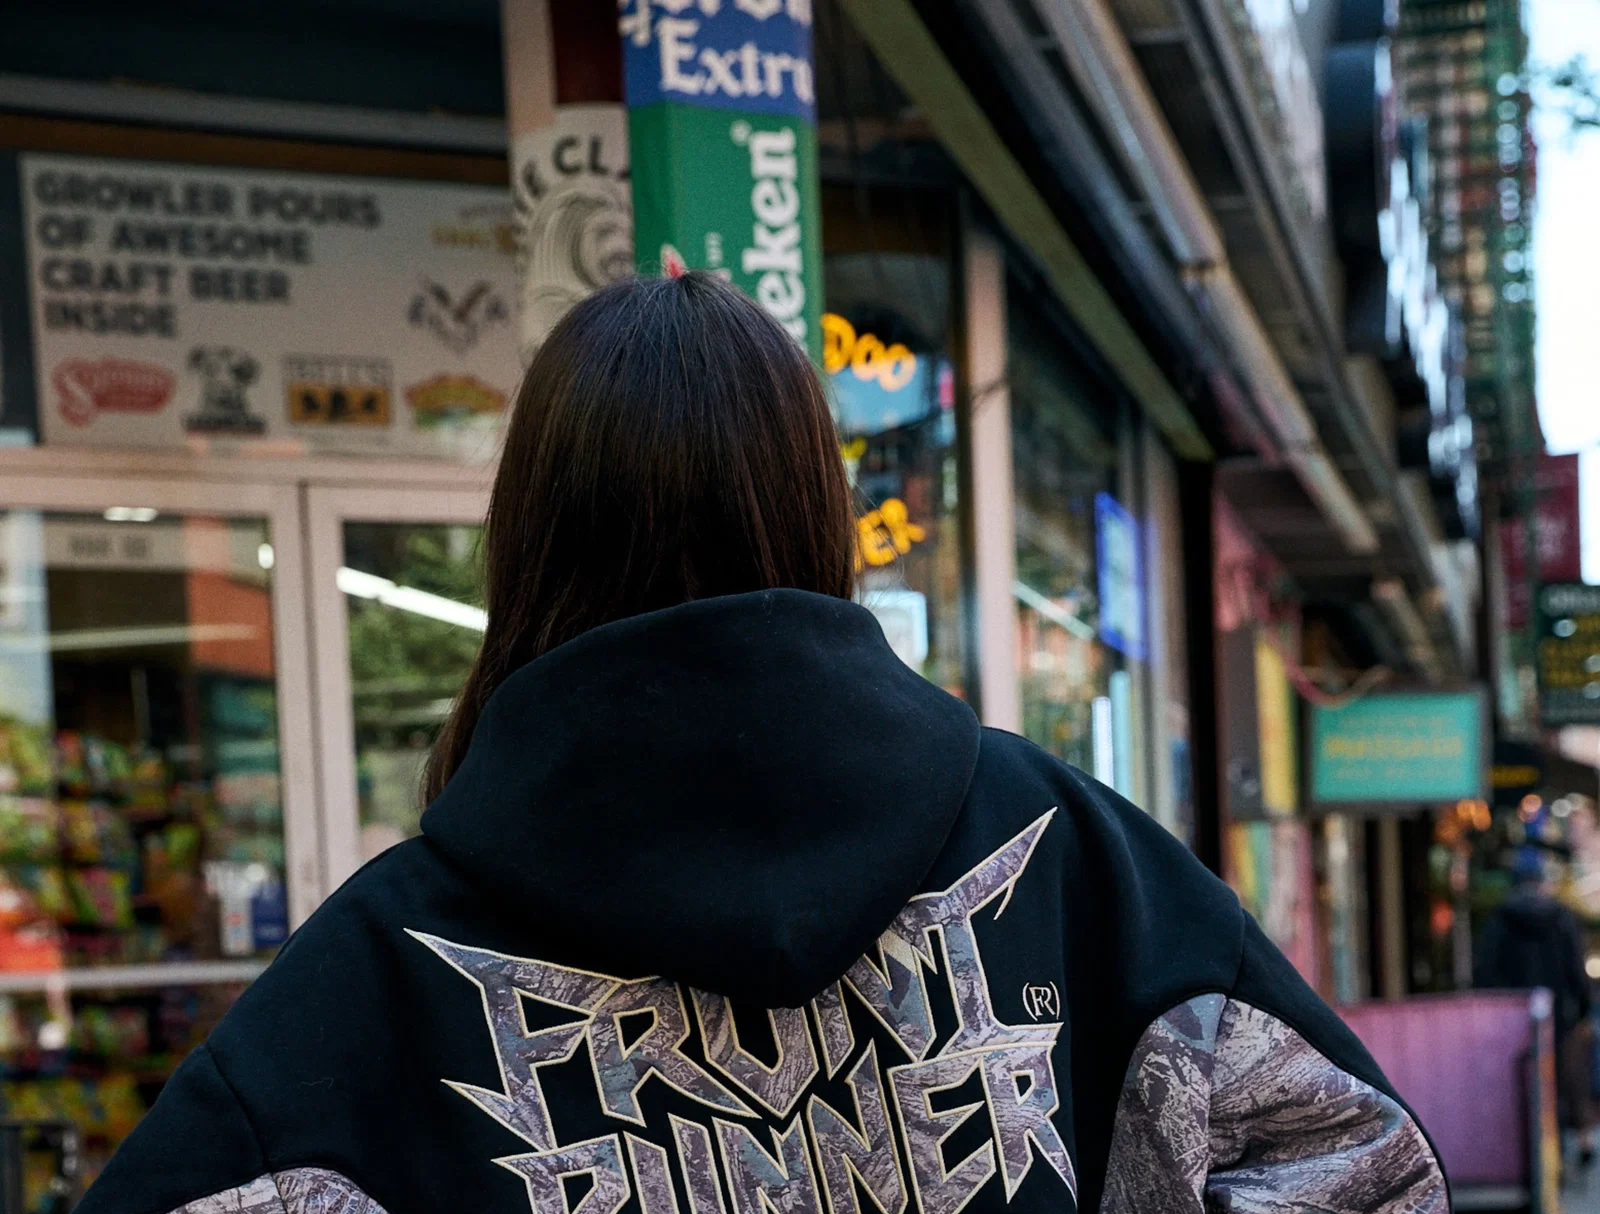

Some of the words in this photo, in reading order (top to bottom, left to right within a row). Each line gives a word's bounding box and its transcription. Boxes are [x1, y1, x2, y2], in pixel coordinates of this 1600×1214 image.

[552, 135, 632, 180] CL
[249, 186, 382, 229] POURS
[38, 214, 93, 247] OF
[111, 219, 312, 264] AWESOME
[43, 257, 174, 296] CRAFT
[189, 264, 293, 304] BEER
[45, 299, 177, 339] INSIDE
